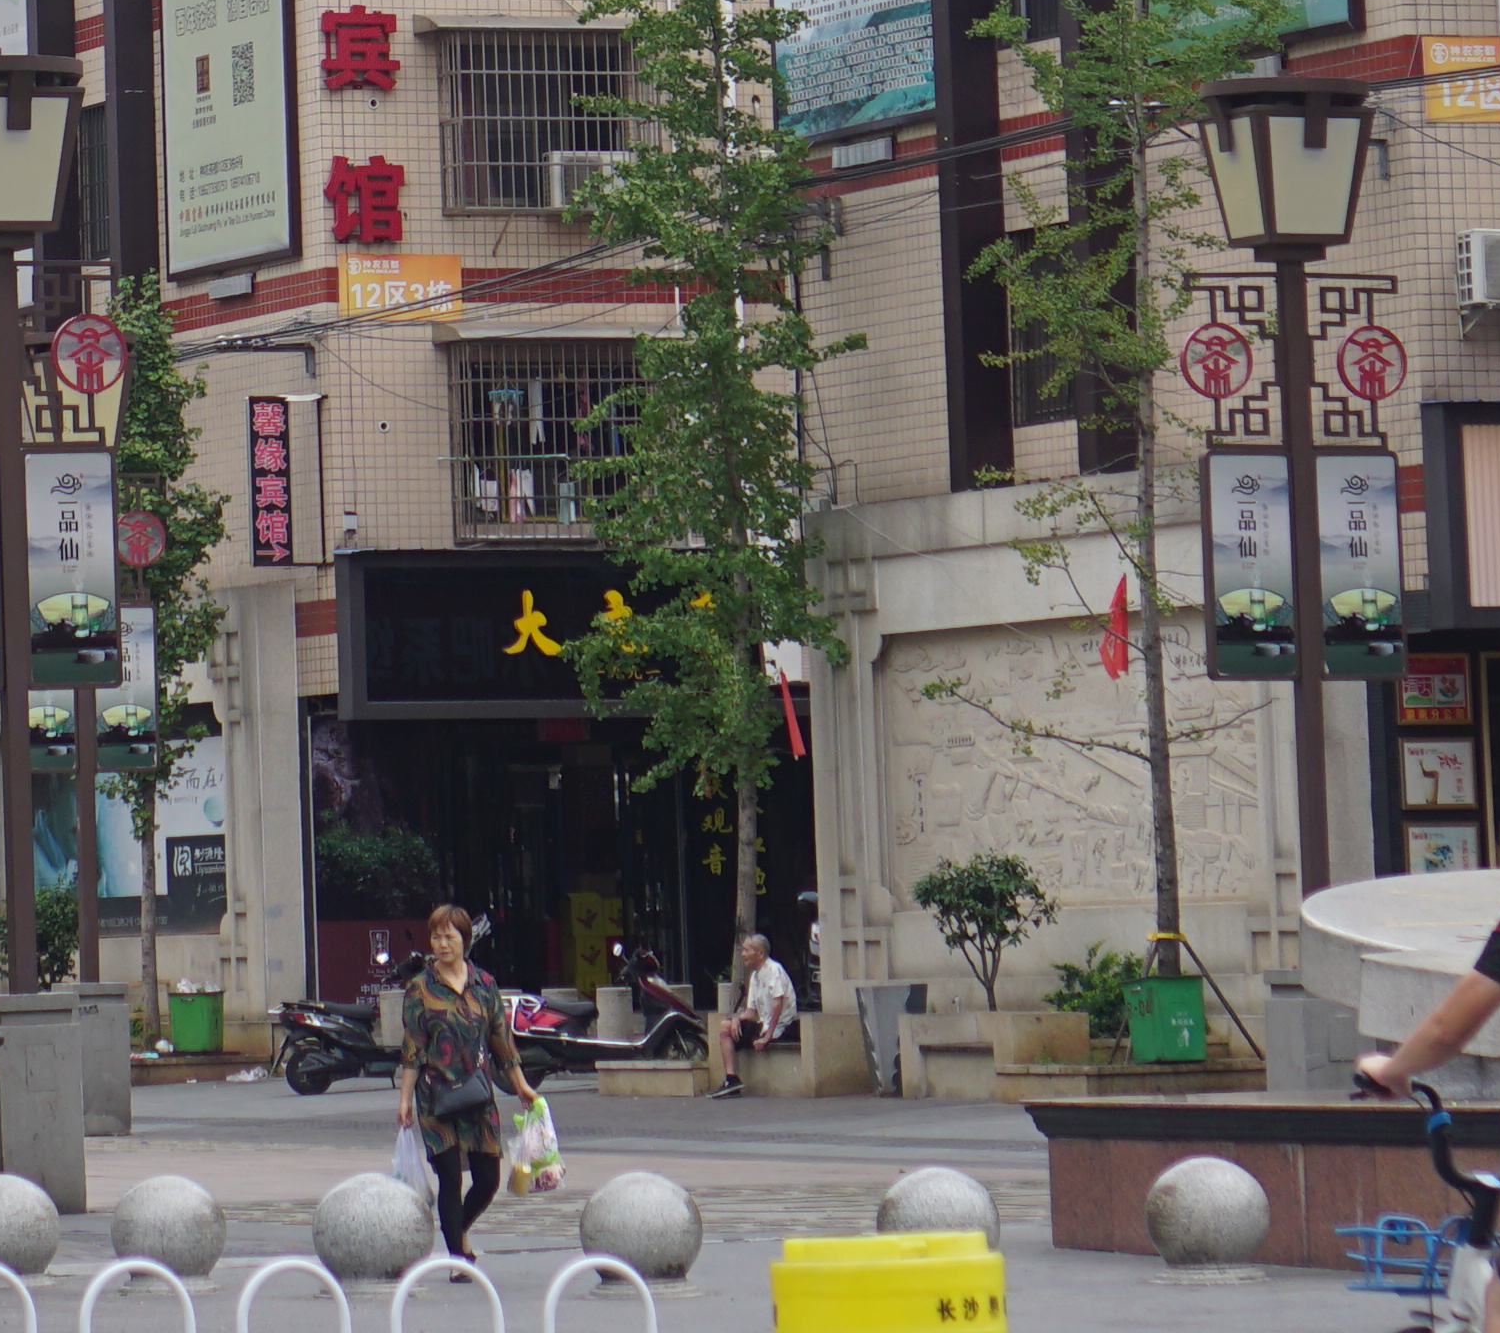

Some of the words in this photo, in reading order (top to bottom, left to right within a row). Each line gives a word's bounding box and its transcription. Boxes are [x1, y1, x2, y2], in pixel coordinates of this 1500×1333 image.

[351, 280, 454, 313] 12区3栋
[253, 402, 289, 545] 馨缘宾馆
[58, 501, 79, 561] 一品仙
[1238, 501, 1257, 559] 一品仙
[1347, 501, 1368, 558] 一品仙
